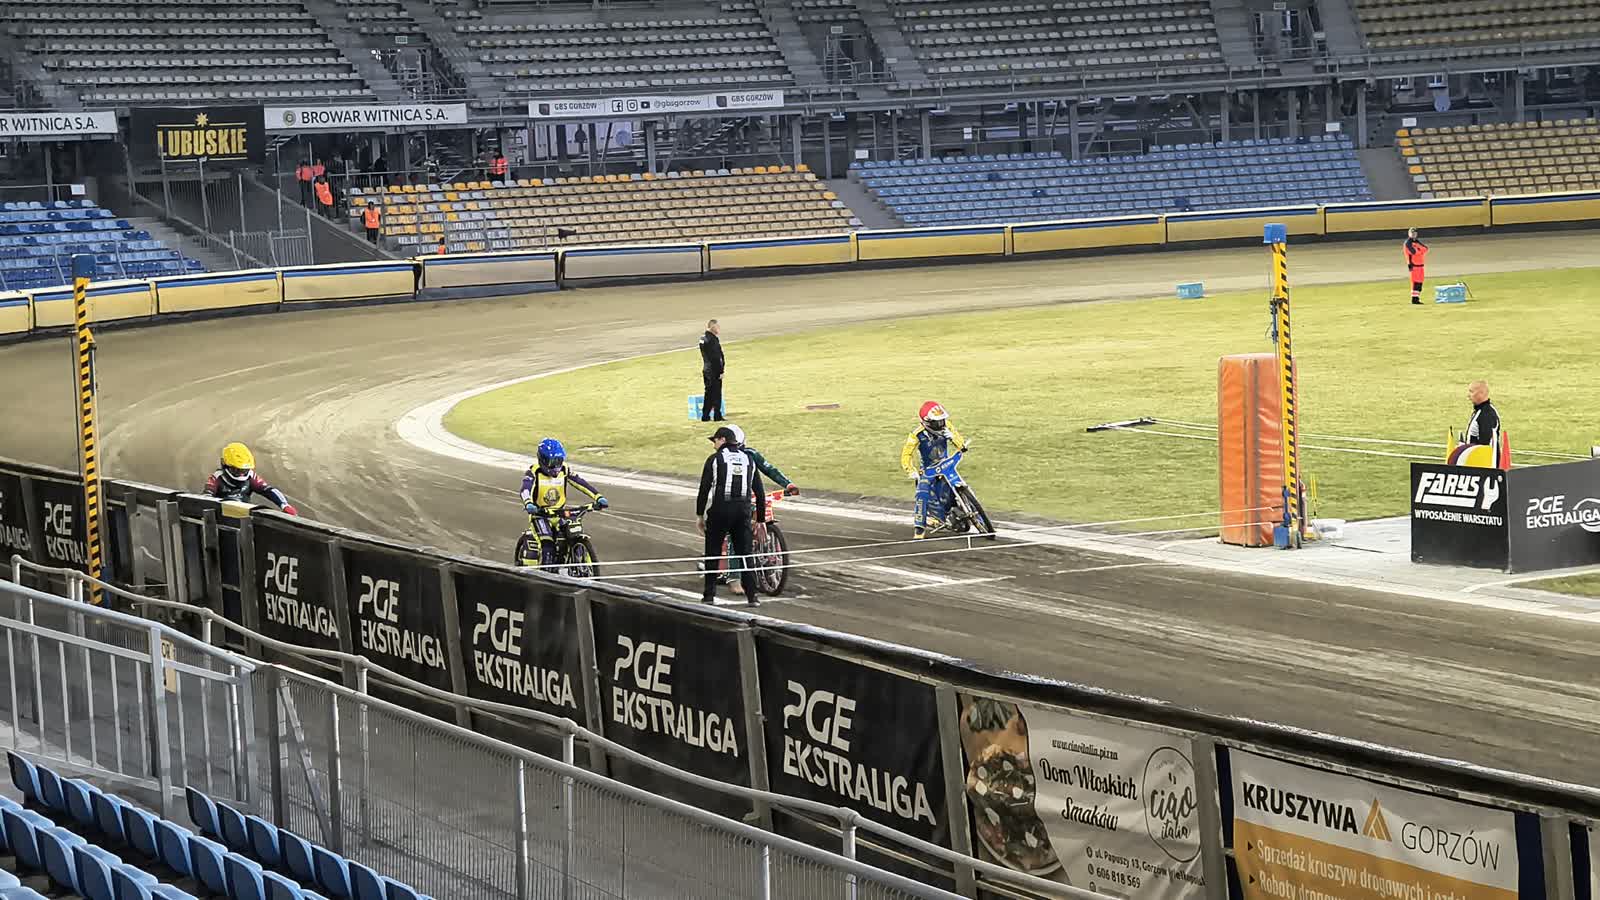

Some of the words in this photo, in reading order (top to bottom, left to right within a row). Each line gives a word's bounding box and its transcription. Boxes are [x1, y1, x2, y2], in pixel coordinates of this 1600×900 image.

[12, 117, 73, 131] WITNICA
[75, 117, 98, 130] S.A.
[302, 110, 361, 124] BROWAR
[364, 108, 422, 122] WITNICA
[425, 108, 449, 121] S.A.
[157, 128, 248, 156] LUBUSKIE
[44, 501, 72, 536] PGE
[1415, 508, 1462, 522] WYPOSAŻENIE
[1463, 513, 1503, 526] WARSZTATU
[1526, 495, 1565, 515] PGE
[1526, 509, 1600, 529] EKSTRALIGA
[264, 551, 299, 595] PGE
[265, 592, 339, 639] EKSTRALIGA
[358, 575, 400, 623] PGE
[361, 619, 446, 670] EKSTRALIGA
[472, 602, 525, 655] PGE
[473, 650, 577, 709] EKSTRALIGA
[613, 634, 675, 695] PGE
[612, 686, 738, 757] EKSTRALIGA
[783, 679, 856, 752] PGE
[783, 735, 937, 826] EKSTRALIGA
[1039, 758, 1073, 785] Dom
[1073, 765, 1138, 801] Włoskich
[1061, 796, 1119, 832] Smaków
[1242, 782, 1358, 834] KRUSZYWA
[1401, 821, 1500, 871] GORZÓW
[1096, 867, 1111, 880] 606
[1111, 870, 1126, 885] 818
[1127, 874, 1141, 889] 569
[1257, 839, 1306, 873] Sprzedaż
[1307, 850, 1359, 887] kruszyw
[1360, 866, 1424, 900] drogowych
[1258, 869, 1297, 900] Roboty
